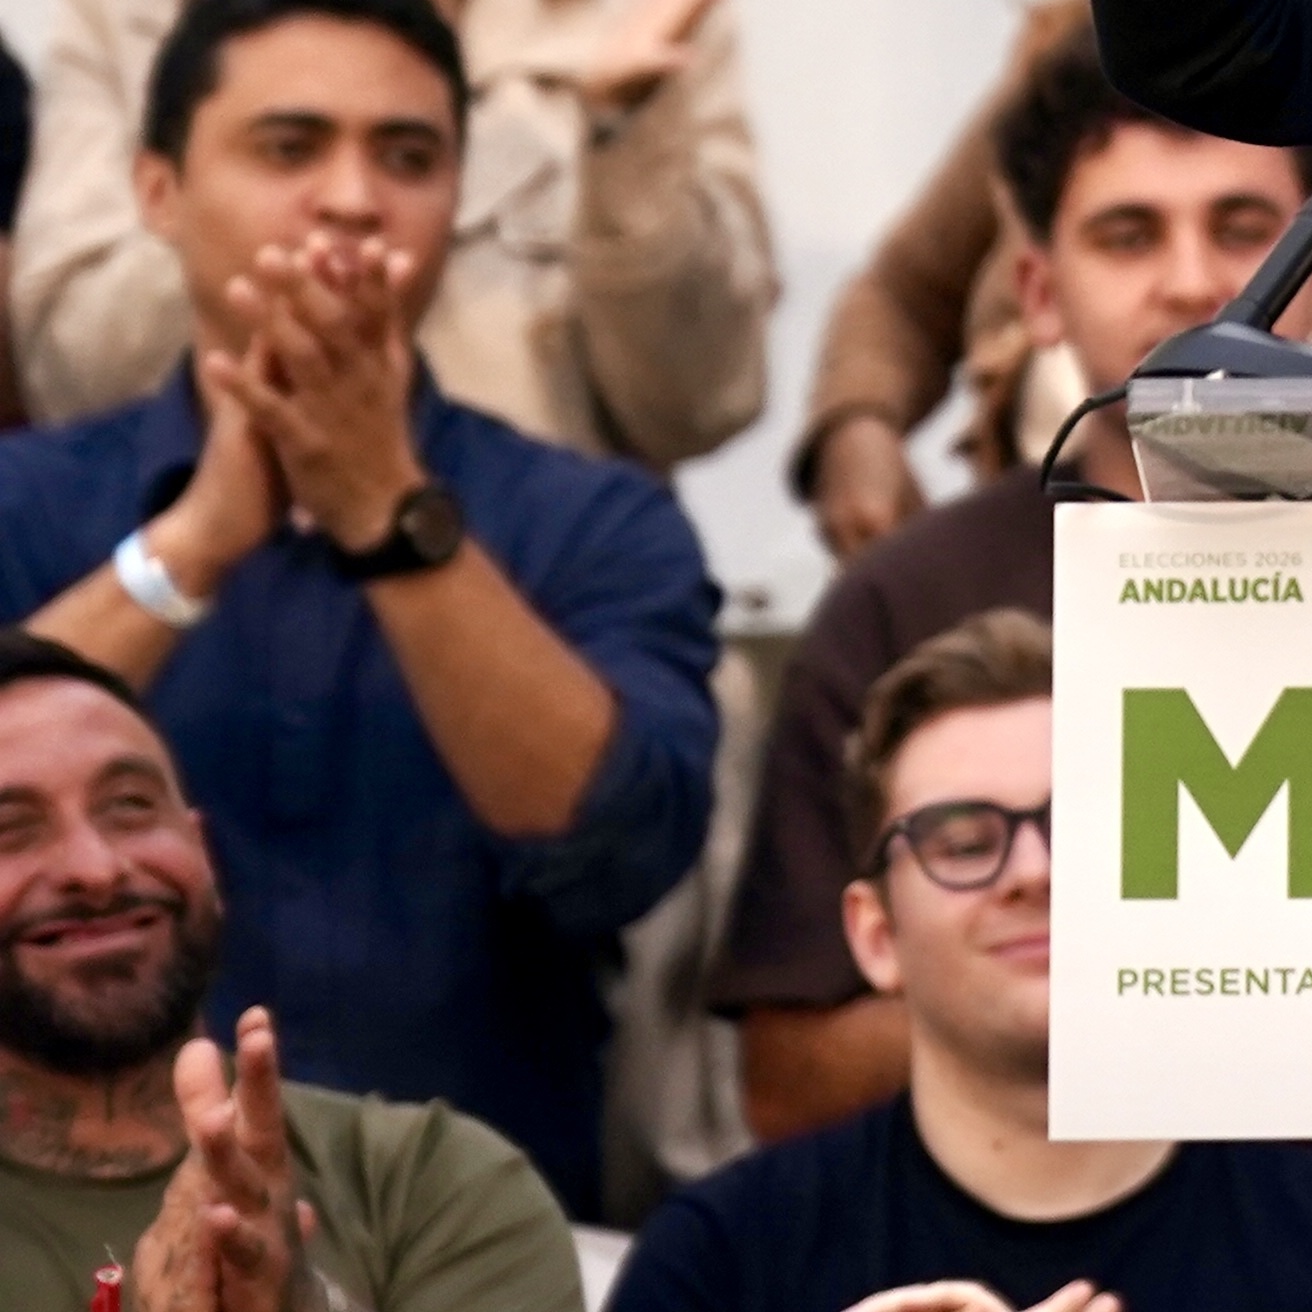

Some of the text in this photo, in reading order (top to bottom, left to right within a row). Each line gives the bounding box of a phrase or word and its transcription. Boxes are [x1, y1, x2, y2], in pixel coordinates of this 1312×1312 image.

[1118, 552, 1304, 569] ELECCIONES 2026
[1118, 572, 1305, 604] ANDALUCÍA
